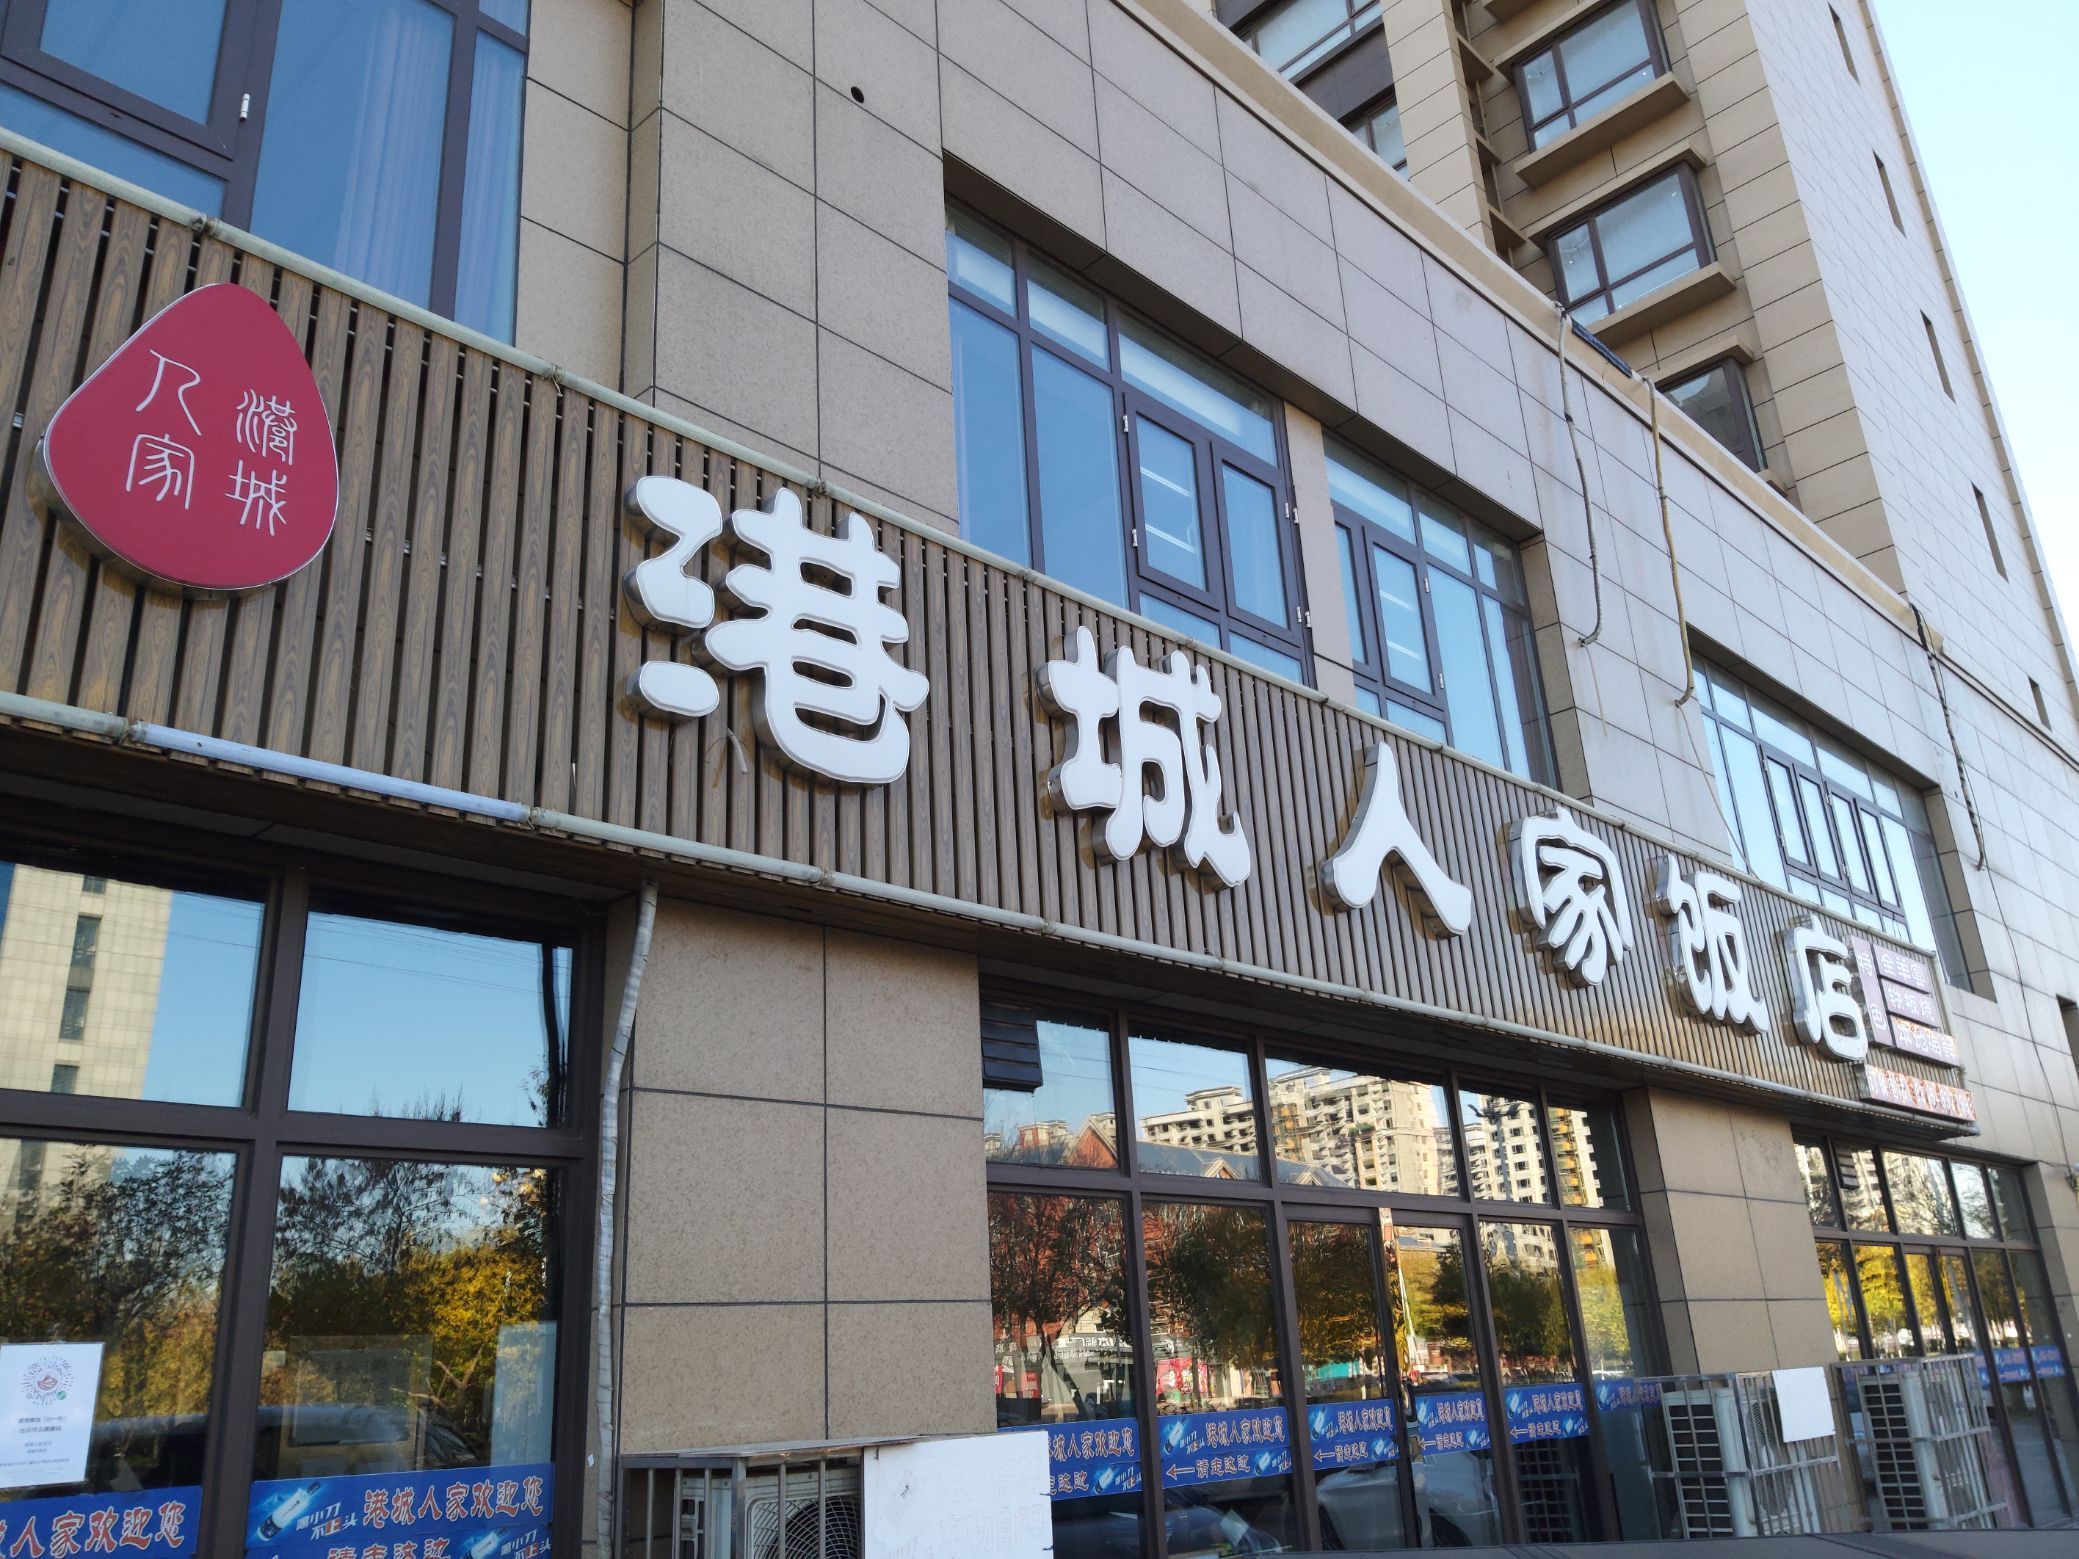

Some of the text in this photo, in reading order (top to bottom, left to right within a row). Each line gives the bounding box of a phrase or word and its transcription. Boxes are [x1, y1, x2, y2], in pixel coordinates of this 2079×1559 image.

[630, 474, 1868, 1062] 港城人家饭店
[1858, 951, 1887, 1031] 特色
[1205, 1415, 1286, 1449] 港城人家欢迎您
[1196, 1454, 1251, 1479] 请走这边
[0, 1501, 186, 1559] 人家欢迎您
[363, 1475, 543, 1529] 港城人家欢迎您
